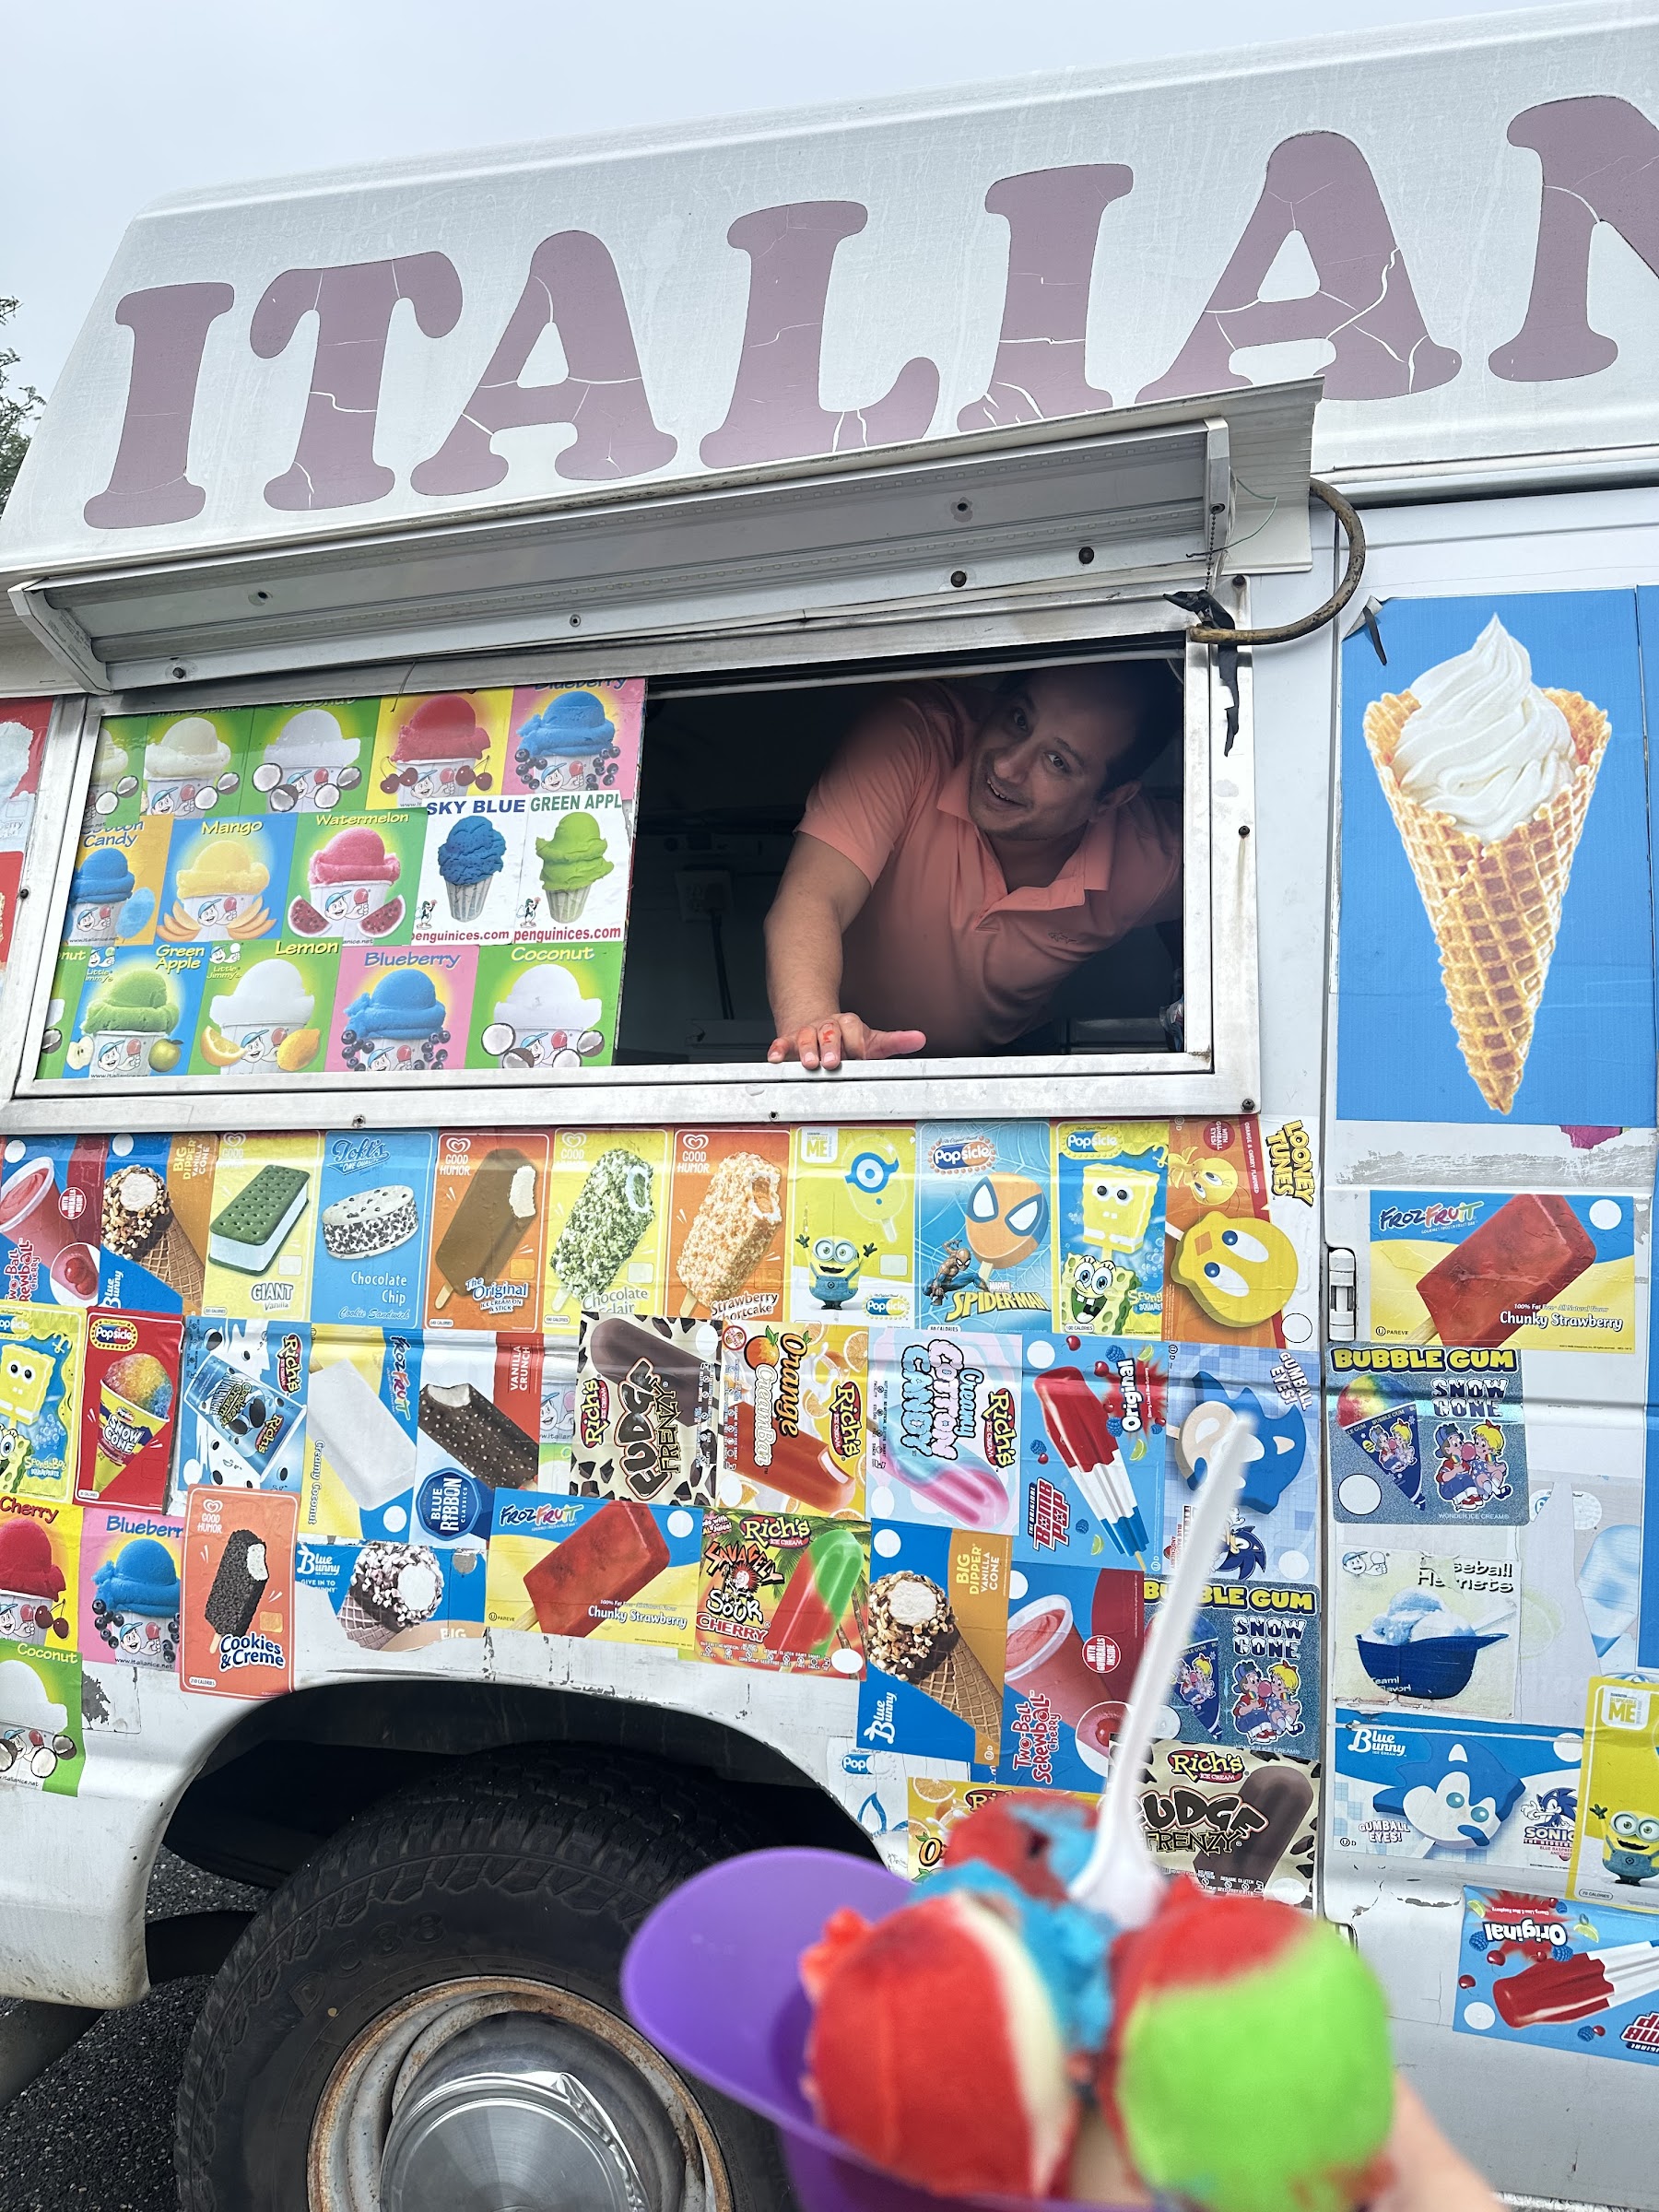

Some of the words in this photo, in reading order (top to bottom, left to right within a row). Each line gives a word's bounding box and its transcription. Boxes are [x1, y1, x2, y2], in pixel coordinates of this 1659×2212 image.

[427, 801, 463, 815] SKY
[473, 800, 525, 814] BLUE
[531, 795, 581, 811] GREEN
[201, 819, 264, 836] Mango
[316, 811, 409, 826] Watermelon
[84, 832, 138, 848] Candy
[513, 926, 621, 944] penguinices.com
[155, 943, 205, 959] Green
[275, 940, 339, 956] Lemon
[364, 950, 461, 969] Blueberry
[511, 946, 595, 963] Coconut
[155, 955, 202, 976] Apple
[213, 965, 239, 973] Little
[806, 1140, 829, 1158] ME
[1066, 1133, 1119, 1148] Popsicle
[173, 1146, 187, 1171] BIG
[183, 1139, 197, 1180] DIPPER
[192, 1143, 203, 1177] VANILLA
[199, 1147, 210, 1175] CONE
[445, 1154, 469, 1165] GOOD
[561, 1148, 585, 1159] GOOD
[683, 1151, 707, 1162] GOOD
[935, 1142, 991, 1165] Popsicle
[1265, 1129, 1295, 1197] TUNES
[1282, 1119, 1315, 1207] LOONEY
[439, 1165, 470, 1176] HUMOR
[677, 1163, 710, 1174] HUMOR
[75, 1194, 83, 1212] INSIDE
[351, 1271, 407, 1288] Chocolate
[465, 1277, 484, 1291] The
[473, 1282, 528, 1300] Original
[989, 1281, 1011, 1291] MARVEL
[251, 1283, 294, 1301] GIANT
[382, 1290, 406, 1306] Chip
[582, 1288, 649, 1311] Chocolate
[711, 1291, 779, 1316] Strawberry
[264, 1300, 289, 1312] Vanilla
[338, 1306, 366, 1319] Cookie
[368, 1307, 410, 1320] Sandwich
[867, 1298, 907, 1312] Popsicle
[945, 1291, 1053, 1323] SPIDER-MAN
[1500, 1311, 1548, 1329] Chunky
[1551, 1313, 1623, 1333] Strawberry
[94, 1328, 133, 1342] Popsicle
[276, 1335, 301, 1394] Rich's
[510, 1345, 522, 1392] VANILLA
[519, 1346, 531, 1392] CRUNCH
[1333, 1348, 1445, 1371] BUBBLE
[1448, 1348, 1516, 1371] GUM
[773, 1333, 809, 1438] Orange
[1269, 1365, 1298, 1406] EYES!
[1279, 1352, 1313, 1411] GUMBALL
[1431, 1378, 1509, 1399] SNOW
[900, 1344, 934, 1458] CANDY
[927, 1338, 965, 1461] COTTON
[957, 1368, 984, 1439] Creamy
[1119, 1358, 1142, 1433] Original
[581, 1378, 610, 1445] Rich's
[829, 1381, 863, 1458] Rich's
[1432, 1398, 1504, 1418] CONE
[108, 1415, 145, 1443] SNOW
[615, 1357, 671, 1501] FUDGE
[655, 1382, 681, 1475] FRENZY
[982, 1390, 1017, 1468] Rich's
[102, 1429, 137, 1454] CONE
[24, 1456, 67, 1471] SpongeBob
[314, 1440, 325, 1480] Creamy
[0, 1496, 60, 1524] Cherry
[308, 1481, 322, 1525] Coconut
[430, 1488, 443, 1521] BLUE
[441, 1477, 463, 1532] RIBBON
[460, 1486, 468, 1524] CLASSICS
[1035, 1479, 1053, 1548] BOMB
[201, 1512, 221, 1524] GOOD
[1053, 1490, 1068, 1545] POP
[1438, 1512, 1467, 1521] WONDER
[197, 1523, 223, 1535] HUMOR
[743, 1516, 811, 1549] Rich's
[703, 1540, 785, 1587] SAVAGELY
[956, 1553, 971, 1585] BIG
[969, 1544, 983, 1595] DIPPER
[981, 1551, 991, 1593] VANILLA
[989, 1556, 1000, 1591] CONE
[706, 1588, 764, 1625] SOUR
[1249, 1588, 1316, 1613] GUM
[587, 1605, 629, 1624] Chunky
[629, 1610, 688, 1630] Strawberry
[696, 1612, 769, 1644] CHERRY
[1231, 1616, 1307, 1640] SNOW
[17, 1642, 78, 1665] Coconut
[220, 1634, 282, 1655] Cookies
[1086, 1644, 1097, 1663] WITH
[1095, 1635, 1106, 1673] GUMBALLS
[1105, 1641, 1117, 1667] INSIDE
[1233, 1637, 1300, 1660] CONE
[114, 1656, 174, 1670] www.italianice.net
[220, 1653, 233, 1672] &
[231, 1650, 287, 1668] Creme
[1608, 1702, 1637, 1724] ME
[1011, 1701, 1032, 1771] Two-Ball
[1030, 1693, 1053, 1785] Screwball
[1046, 1712, 1063, 1753] Cherry
[1171, 1749, 1244, 1783] Rich's
[1212, 1773, 1236, 1782] CREAM
[1358, 1819, 1411, 1834] GUMBALL
[1368, 1830, 1403, 1844] EYES!
[1143, 1830, 1243, 1856] FRENZY
[1483, 1918, 1567, 1947] Original
